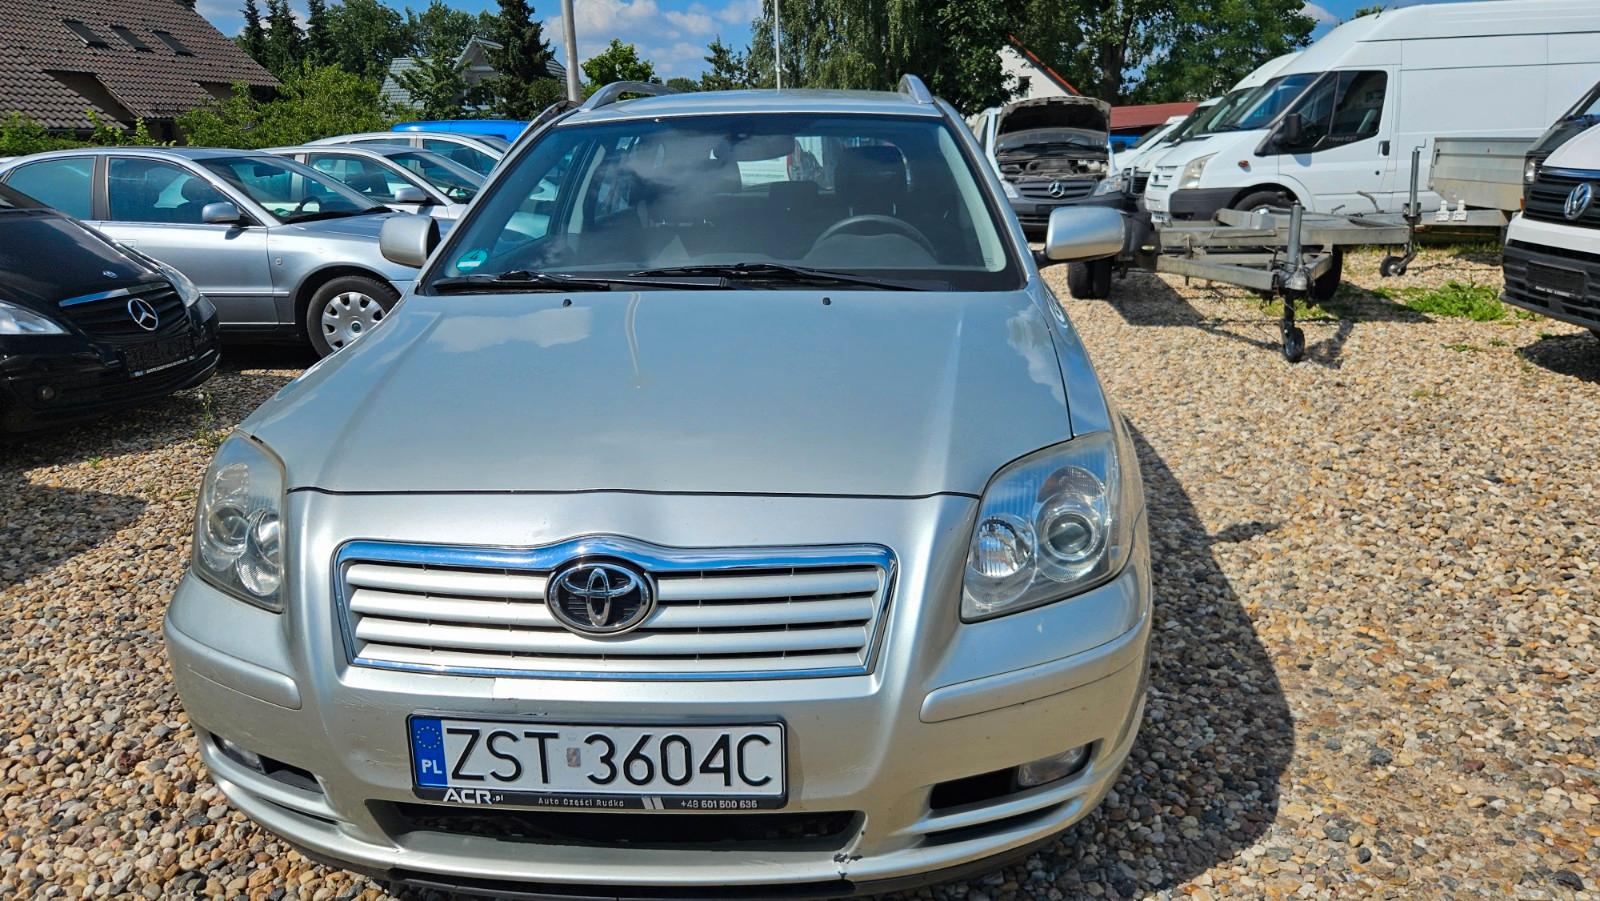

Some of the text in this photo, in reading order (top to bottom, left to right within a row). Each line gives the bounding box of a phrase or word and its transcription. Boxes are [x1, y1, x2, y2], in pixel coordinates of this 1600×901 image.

[446, 727, 773, 788] ZST 3604C
[421, 759, 443, 774] PL
[538, 797, 560, 805] Auto
[681, 800, 699, 808] +48
